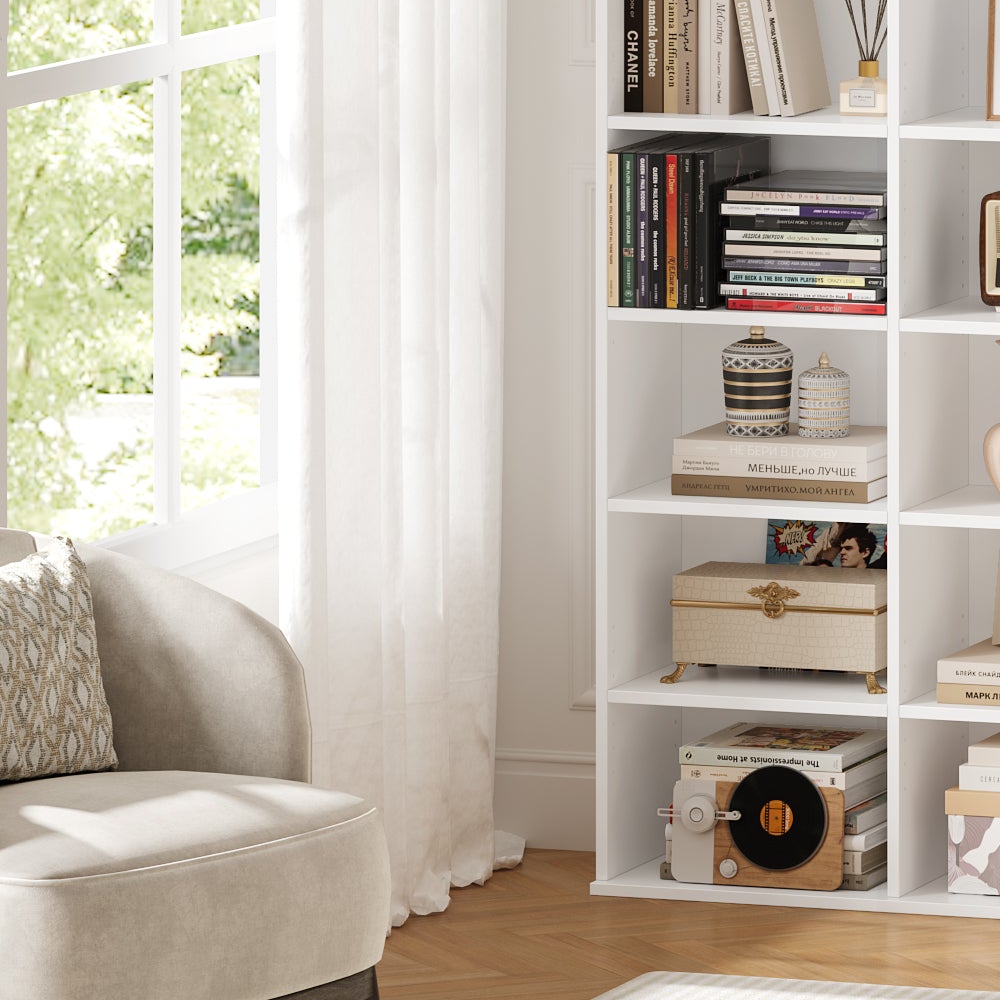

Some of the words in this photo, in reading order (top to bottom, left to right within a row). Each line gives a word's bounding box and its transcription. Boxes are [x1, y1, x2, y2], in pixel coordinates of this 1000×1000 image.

[648, 0, 658, 37] amanda
[714, 2, 726, 46] McCartney
[737, 1, 754, 46] СПАСИТЕ
[627, 30, 639, 93] CHANEL
[648, 39, 659, 78] lovelace
[666, 32, 678, 88] Huffington
[744, 46, 762, 88] КОТИКА!
[742, 232, 761, 240] JESSICA
[729, 445, 745, 455] НЕ
[747, 446, 778, 457] БЕРИ
[780, 447, 789, 457] В
[790, 447, 839, 459] ГОЛОВУ
[817, 466, 857, 477] ЛУЧШЕ
[823, 488, 855, 497] АНГЕЛ
[955, 669, 977, 677] БЛЕЙК
[965, 691, 991, 700] МАРК
[717, 754, 738, 763] Home
[750, 755, 804, 767] Impressionists
[806, 759, 820, 768] The
